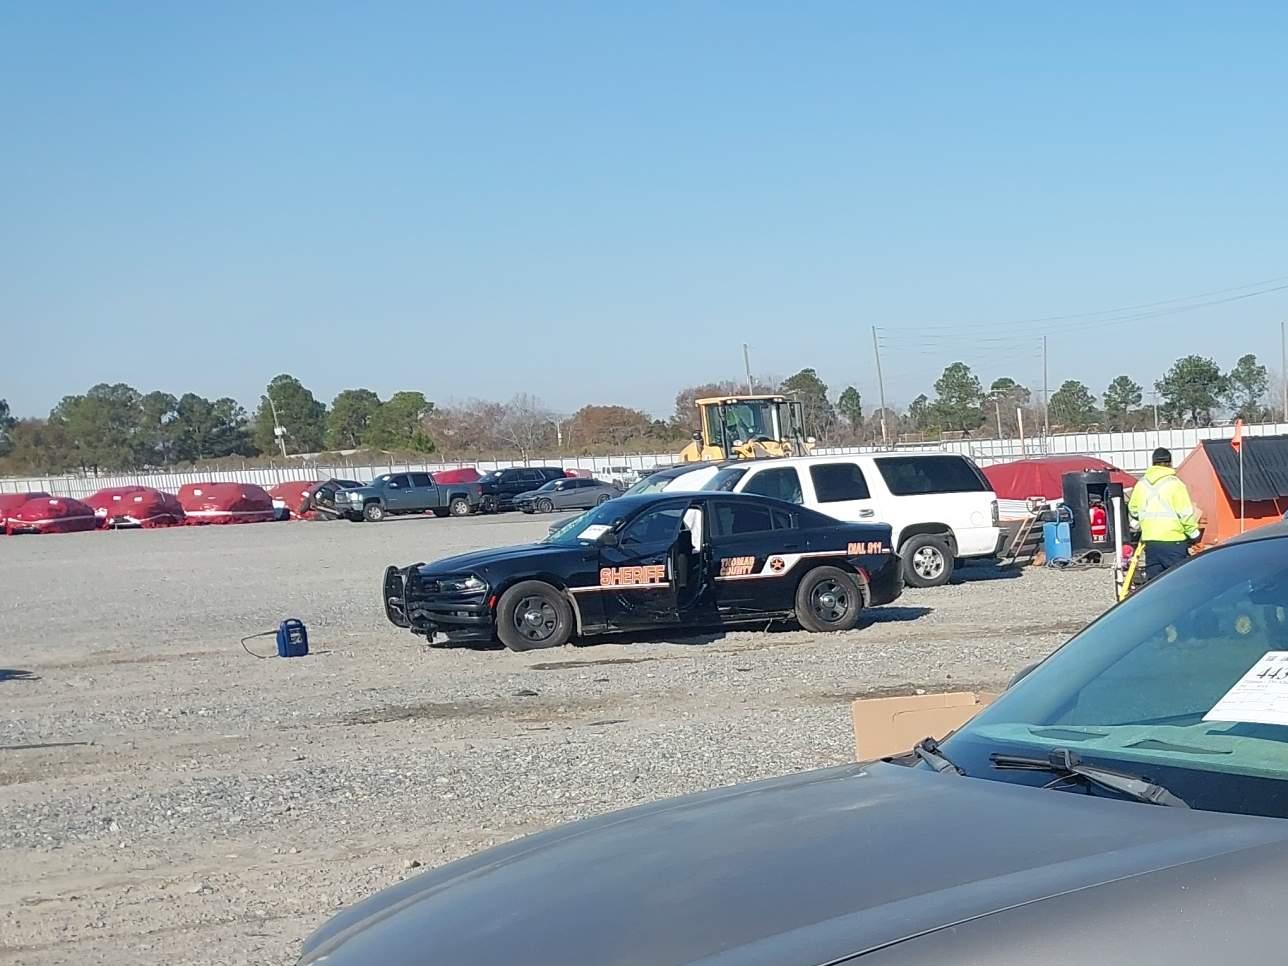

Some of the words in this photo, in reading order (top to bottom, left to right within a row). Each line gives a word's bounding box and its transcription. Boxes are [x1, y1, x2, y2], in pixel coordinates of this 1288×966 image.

[847, 542, 866, 555] DIAL
[867, 541, 882, 554] 911
[600, 565, 666, 586] SHERIFF
[720, 566, 753, 576] COUNTY
